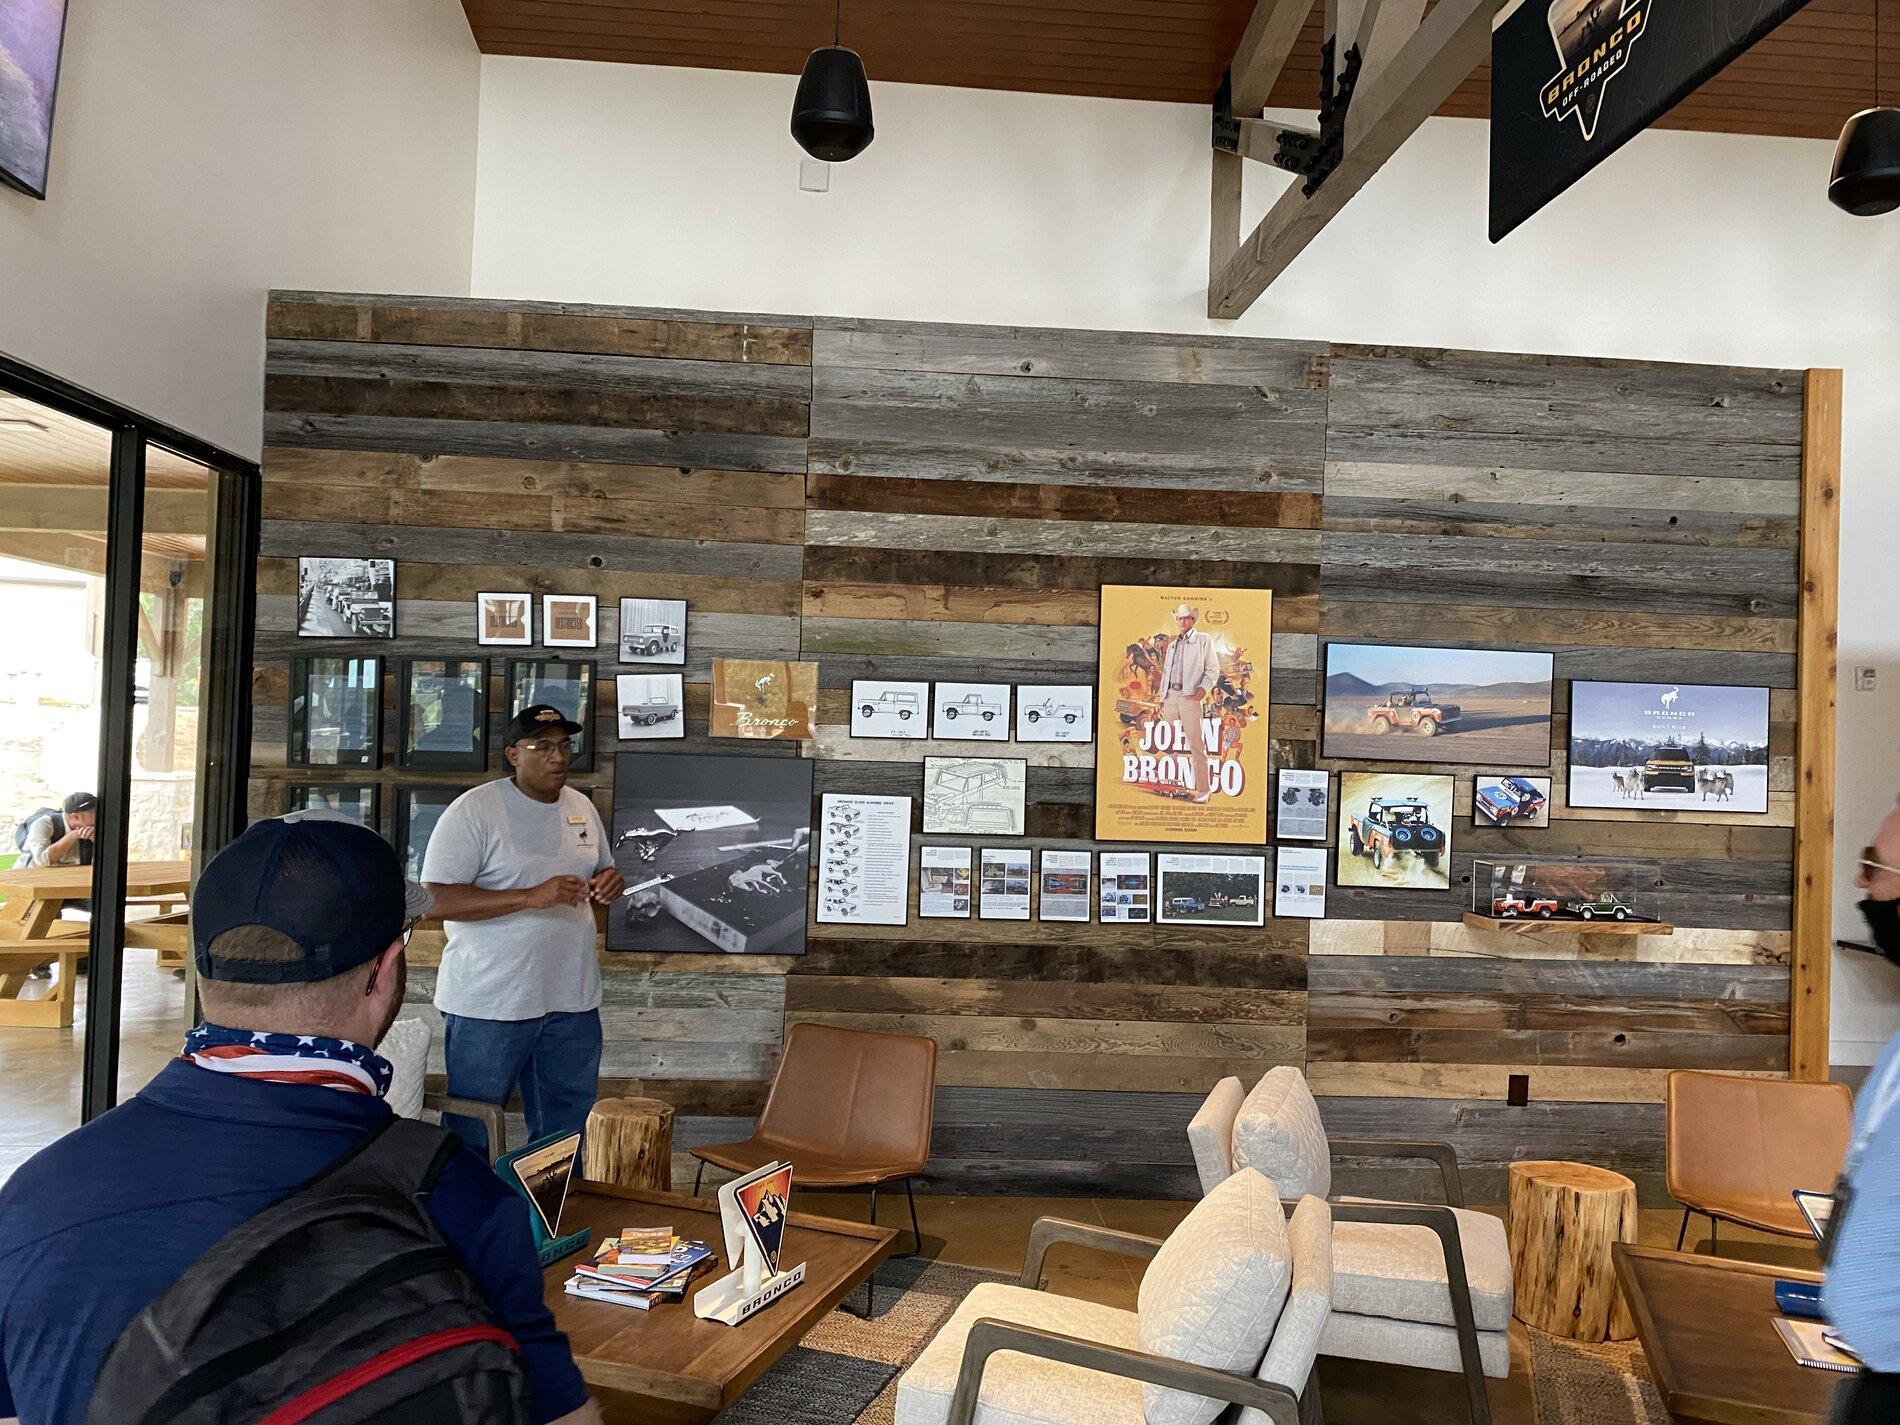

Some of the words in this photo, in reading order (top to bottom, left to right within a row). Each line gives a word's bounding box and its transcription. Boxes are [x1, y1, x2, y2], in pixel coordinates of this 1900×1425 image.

[1548, 10, 1642, 104] BRONCO
[1562, 49, 1623, 107] OFF-ROADEO
[730, 711, 799, 728] Bronco
[1138, 718, 1222, 753] JOHN
[1122, 755, 1243, 797] BRONCO
[741, 1270, 802, 1316] BRONCO
